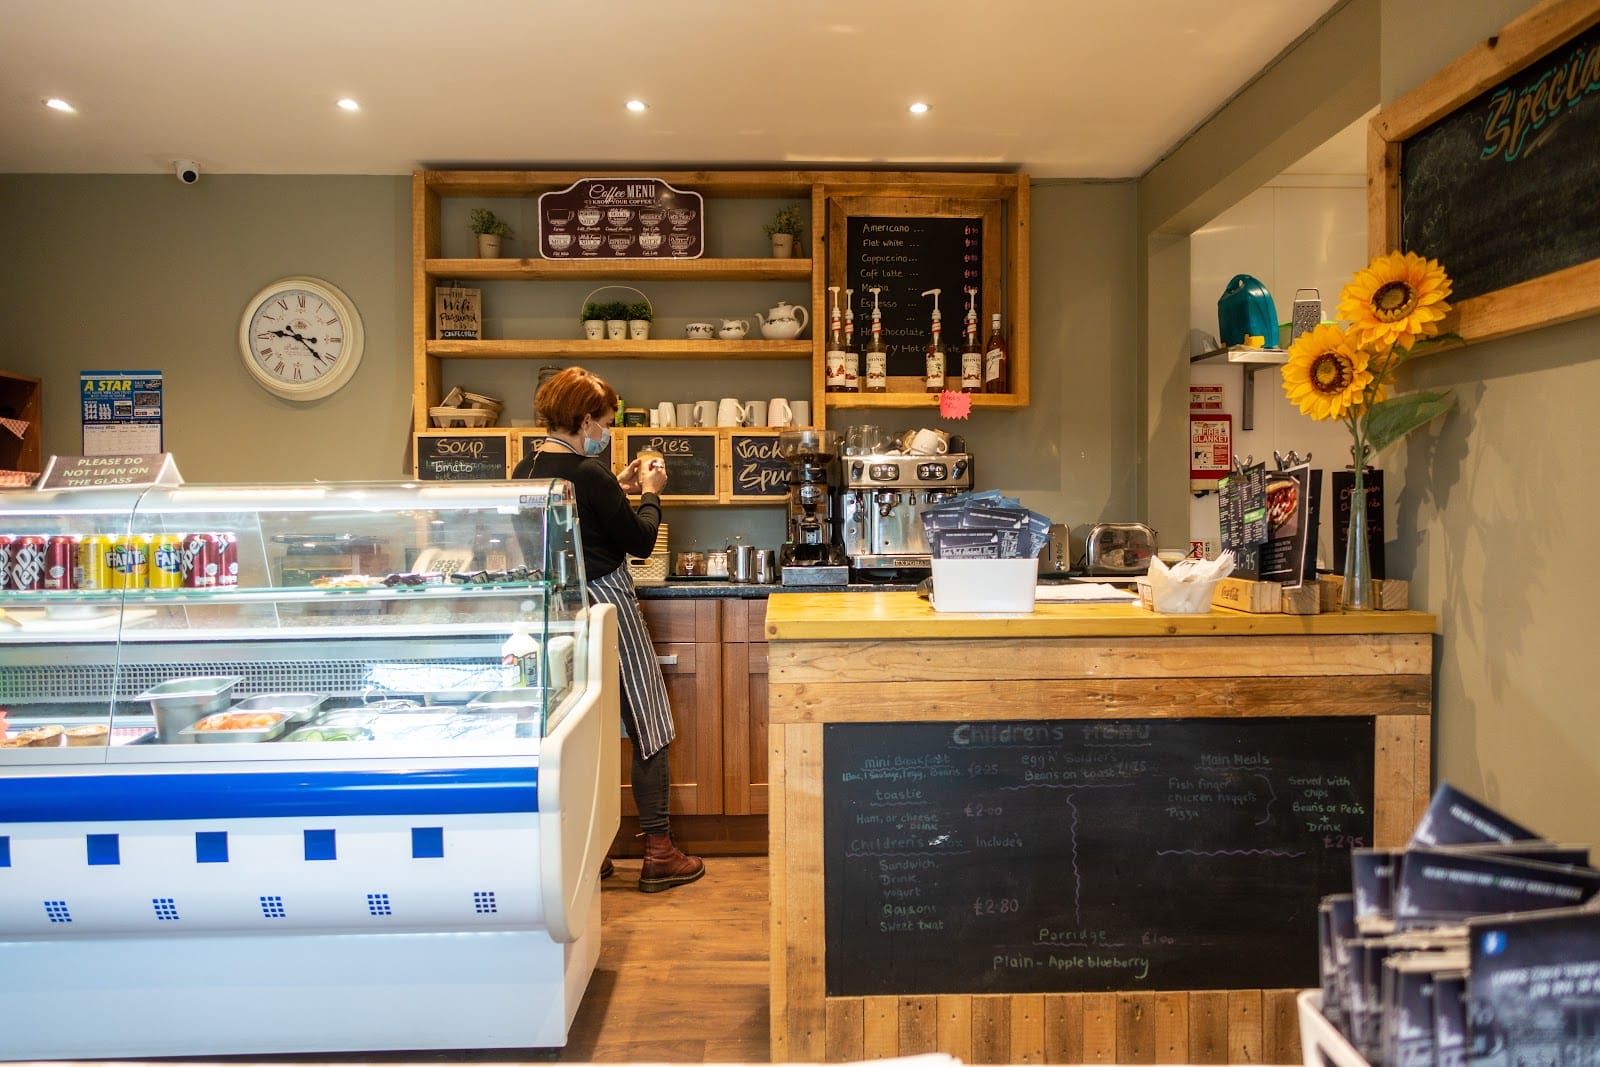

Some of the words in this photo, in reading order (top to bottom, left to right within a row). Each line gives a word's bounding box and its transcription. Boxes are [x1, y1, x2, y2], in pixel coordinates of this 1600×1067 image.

[589, 184, 625, 203] Coffee
[627, 184, 655, 198] MENU
[863, 224, 910, 234] Americano
[863, 239, 880, 247] Flat
[860, 300, 898, 309] Espesso
[84, 381, 94, 391] A
[97, 381, 131, 391] STAR
[1202, 428, 1220, 436] FIRE
[1193, 435, 1228, 443] BLANKET
[436, 438, 484, 459] Soup
[650, 437, 690, 452] Pie's
[78, 458, 121, 466] PLEASE
[124, 457, 143, 465] DO
[63, 469, 90, 477] NOT
[93, 468, 126, 476] LEAN
[98, 477, 133, 485] GLASS
[16, 544, 37, 571] Dr
[154, 551, 181, 568] FAN
[12, 540, 50, 590] Pepp
[864, 757, 890, 767] mini
[1201, 754, 1230, 765] Main
[1233, 752, 1270, 766] Meals
[1168, 777, 1194, 789] Fish
[1288, 776, 1322, 786] Served
[1327, 775, 1351, 786] with
[875, 788, 923, 801] toastie
[1326, 805, 1337, 813] or
[885, 814, 897, 823] or
[1307, 822, 1341, 832] Drink
[1038, 927, 1107, 944] Porridge
[993, 953, 1034, 970] Plain
[1049, 956, 1084, 971] Apple
